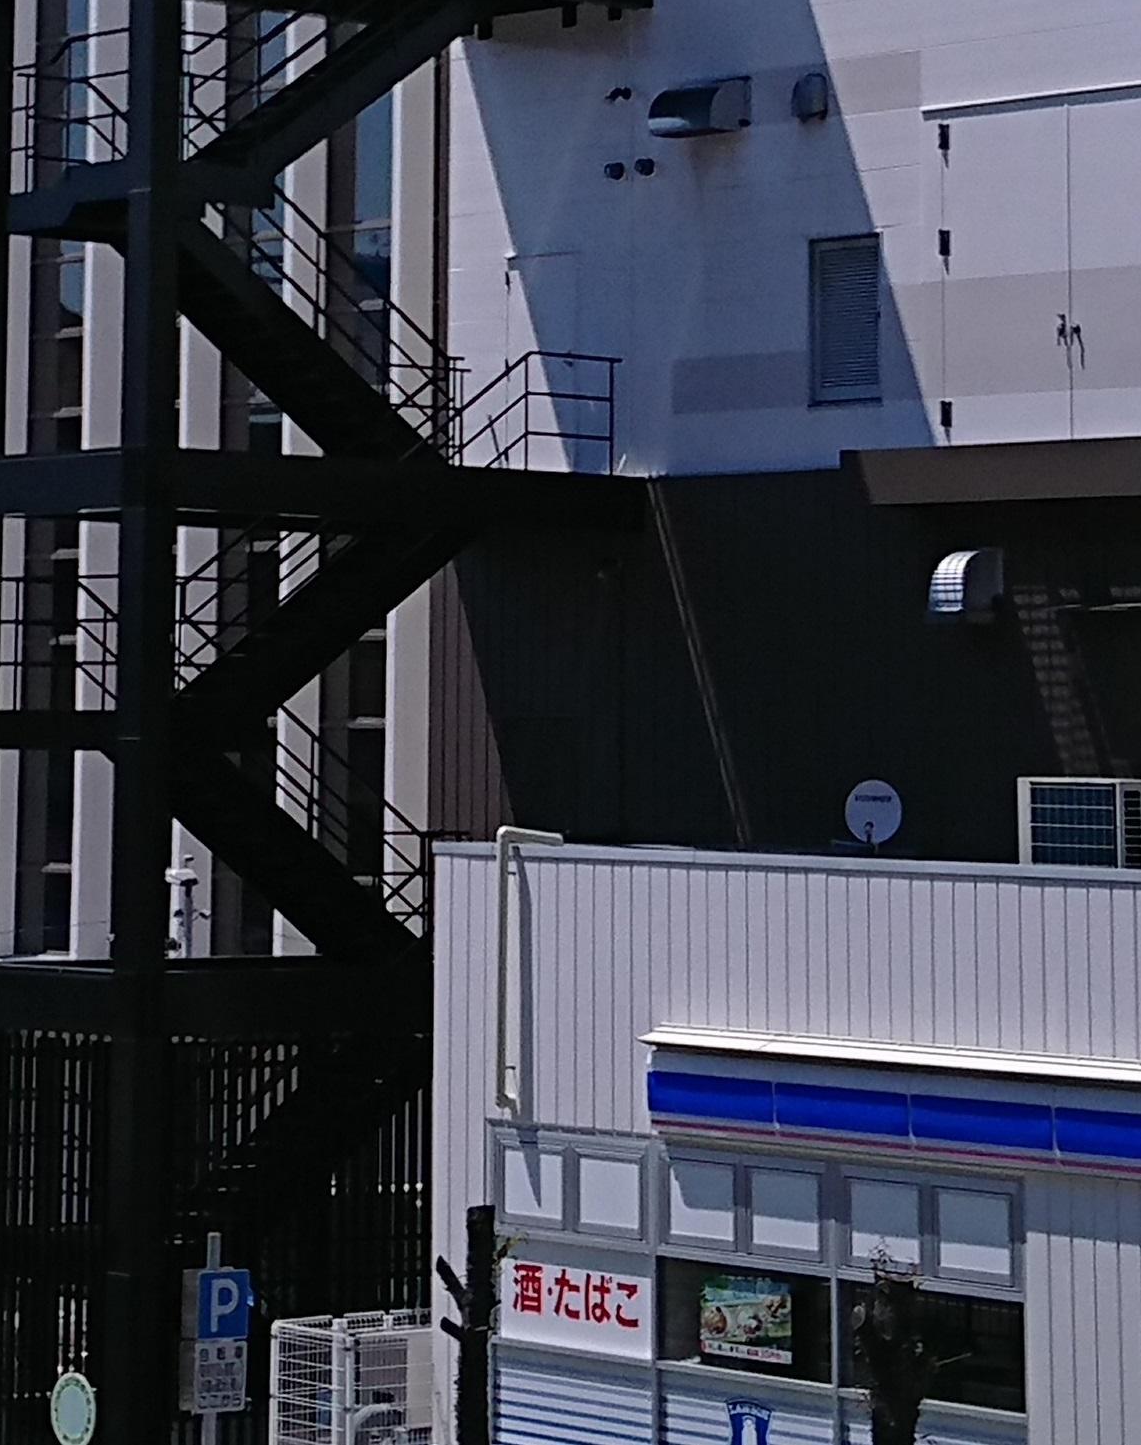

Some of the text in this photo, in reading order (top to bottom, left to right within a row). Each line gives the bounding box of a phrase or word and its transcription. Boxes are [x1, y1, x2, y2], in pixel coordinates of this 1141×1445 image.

[210, 1277, 240, 1333] P
[513, 1263, 639, 1328] 酒・たばこ
